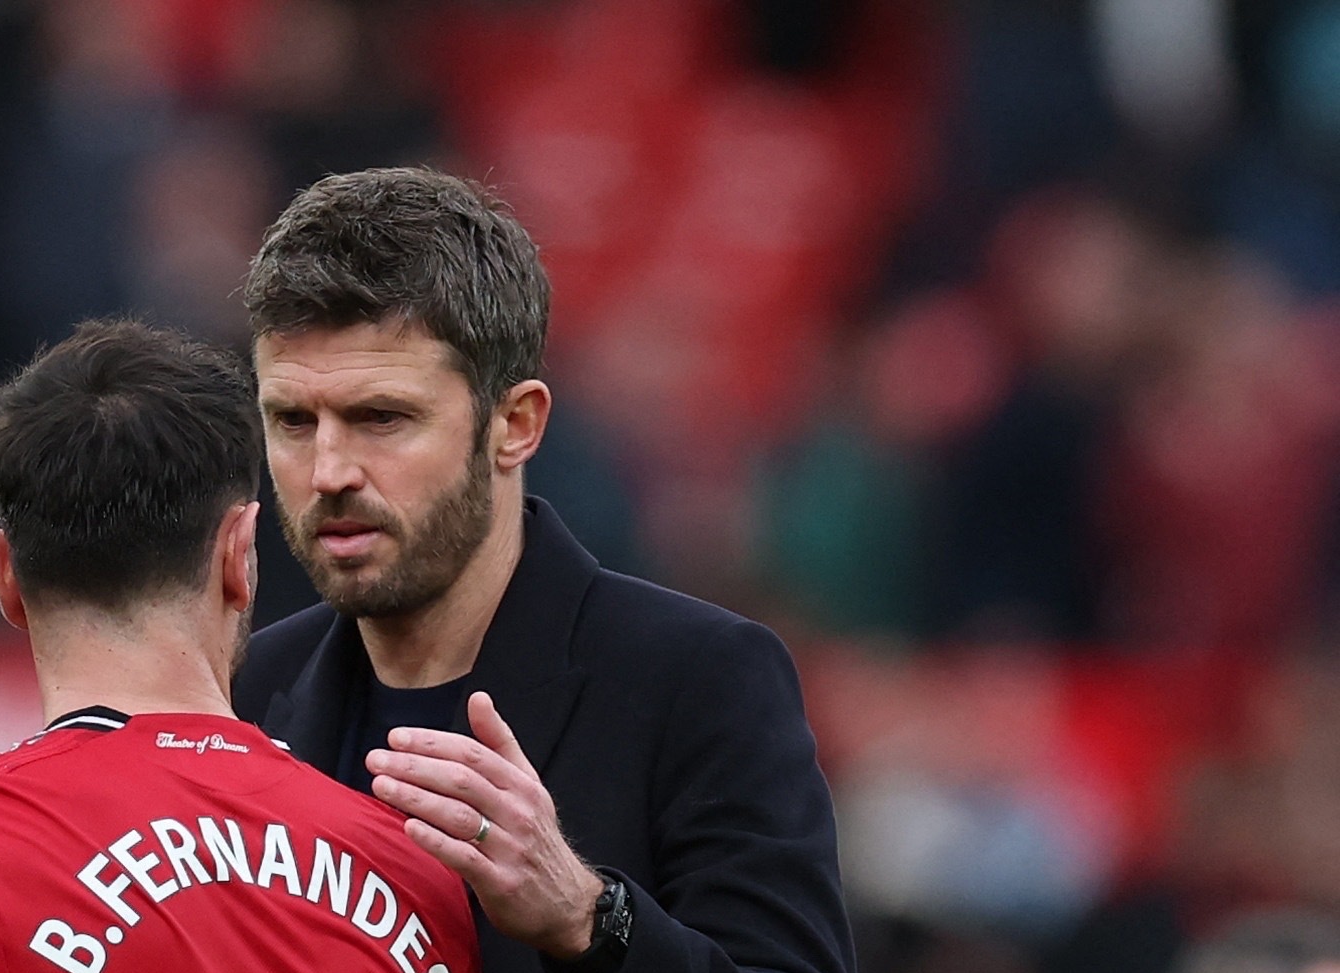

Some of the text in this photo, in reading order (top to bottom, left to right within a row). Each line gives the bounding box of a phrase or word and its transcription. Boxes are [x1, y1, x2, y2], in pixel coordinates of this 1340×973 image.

[156, 732, 250, 754] Theatre of Dreams
